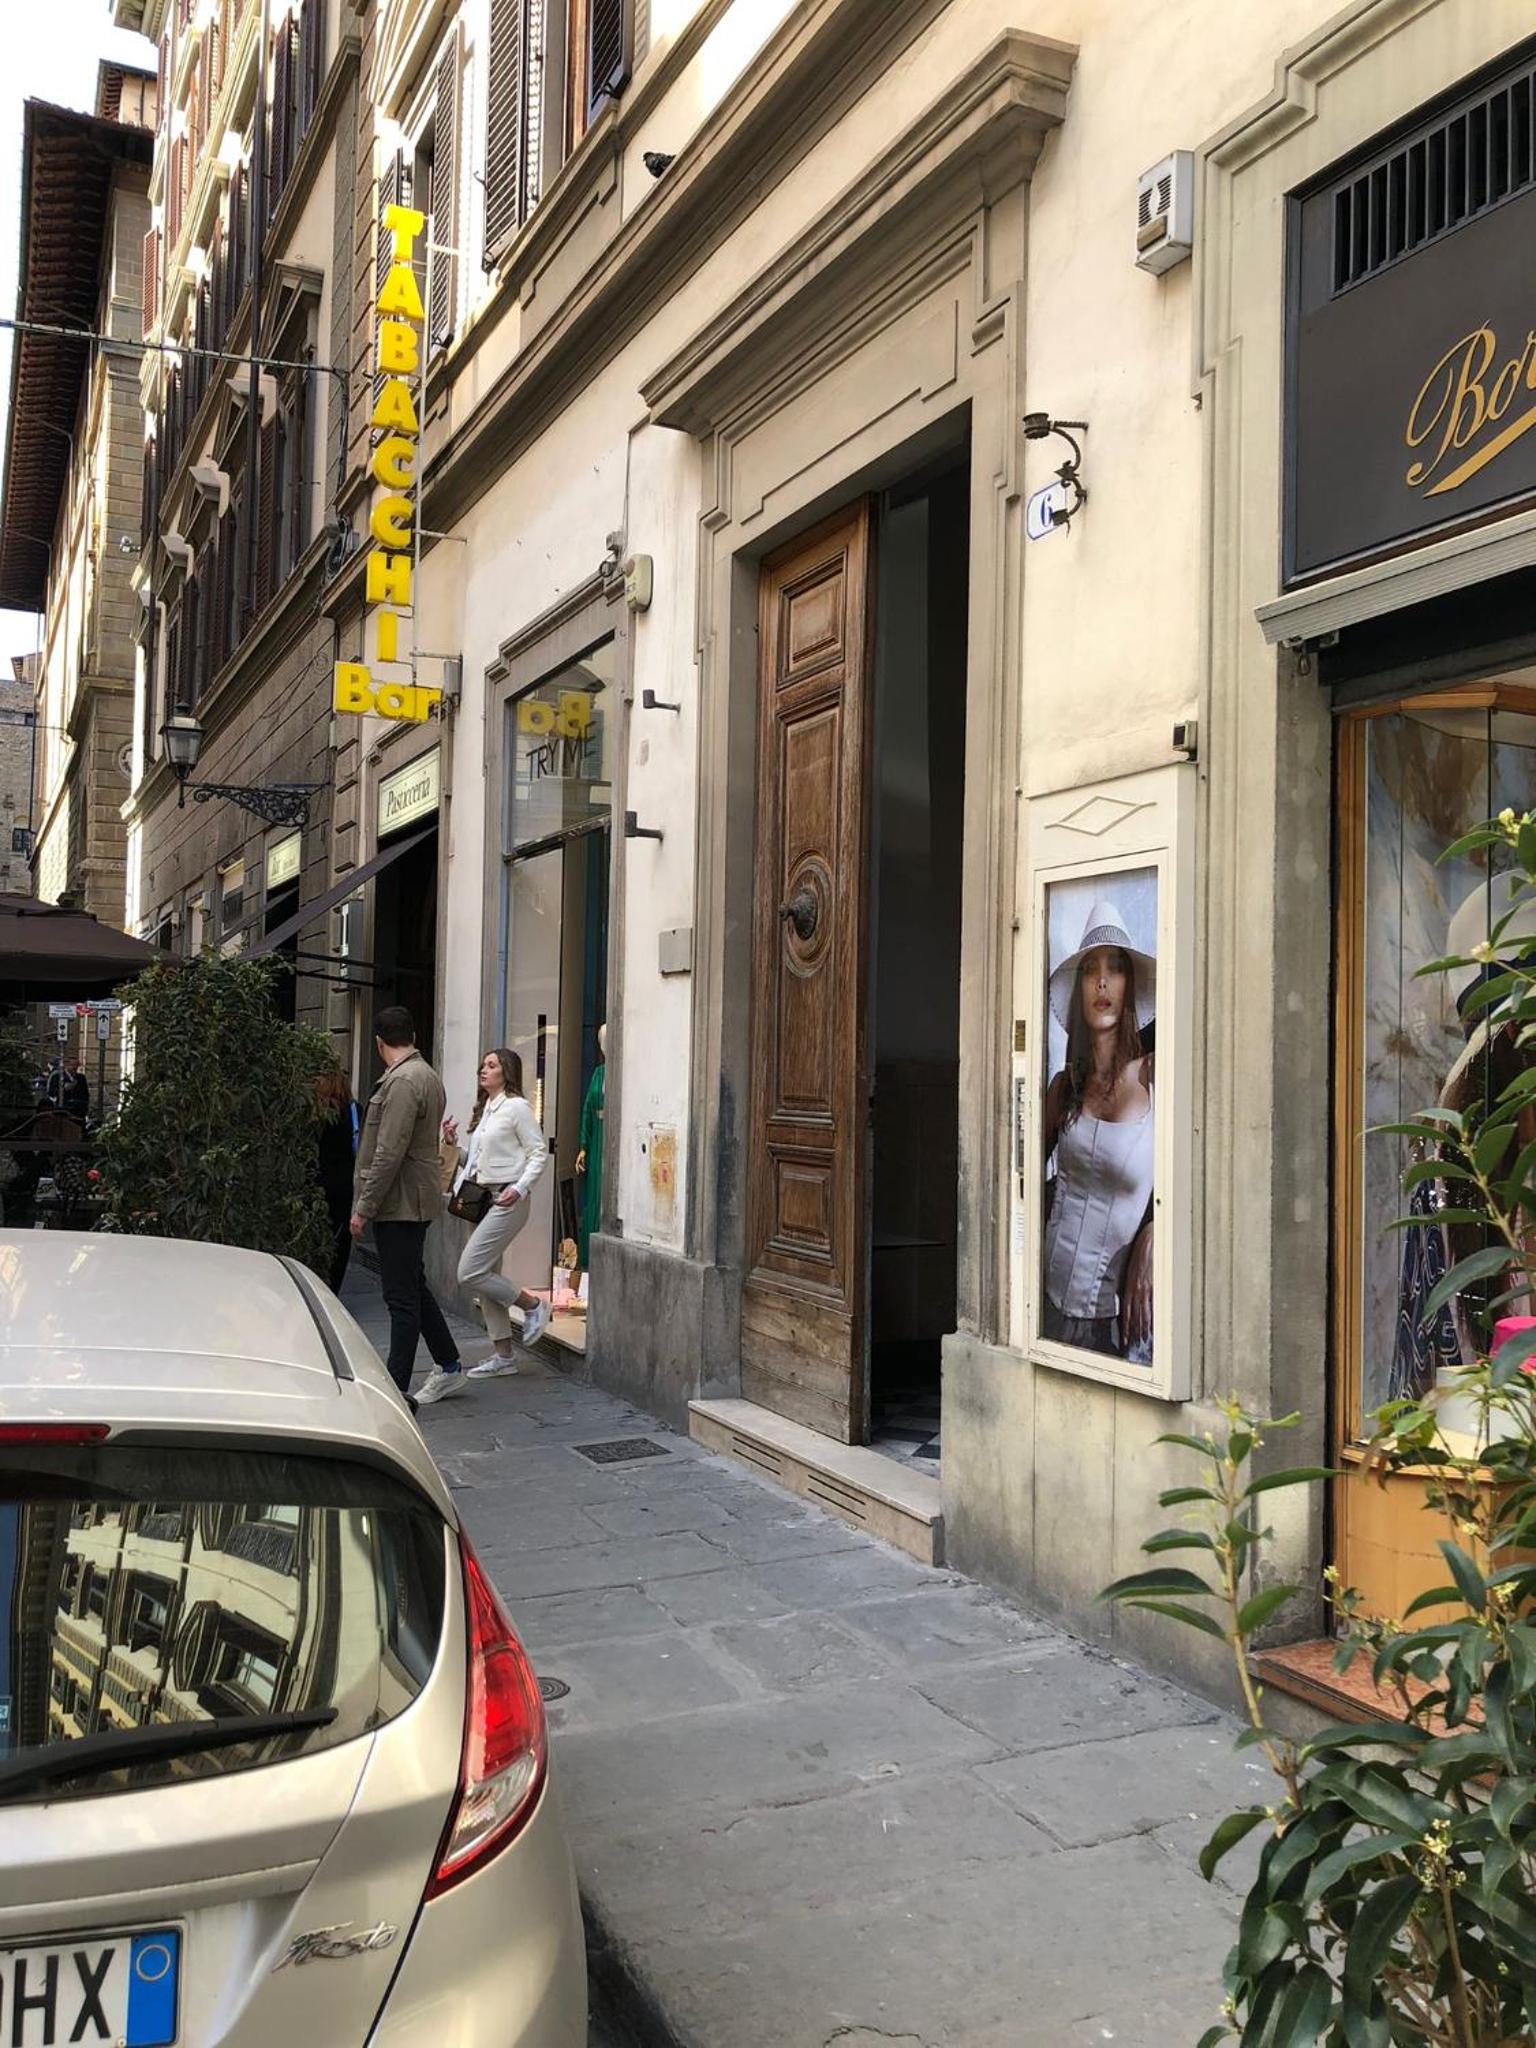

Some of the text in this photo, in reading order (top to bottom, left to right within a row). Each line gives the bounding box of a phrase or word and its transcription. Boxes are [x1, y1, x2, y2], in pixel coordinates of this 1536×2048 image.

[366, 203, 425, 663] TABACCHI
[333, 660, 442, 724] Bar
[525, 738, 559, 782] TRY
[0, 1947, 116, 2048] HX
